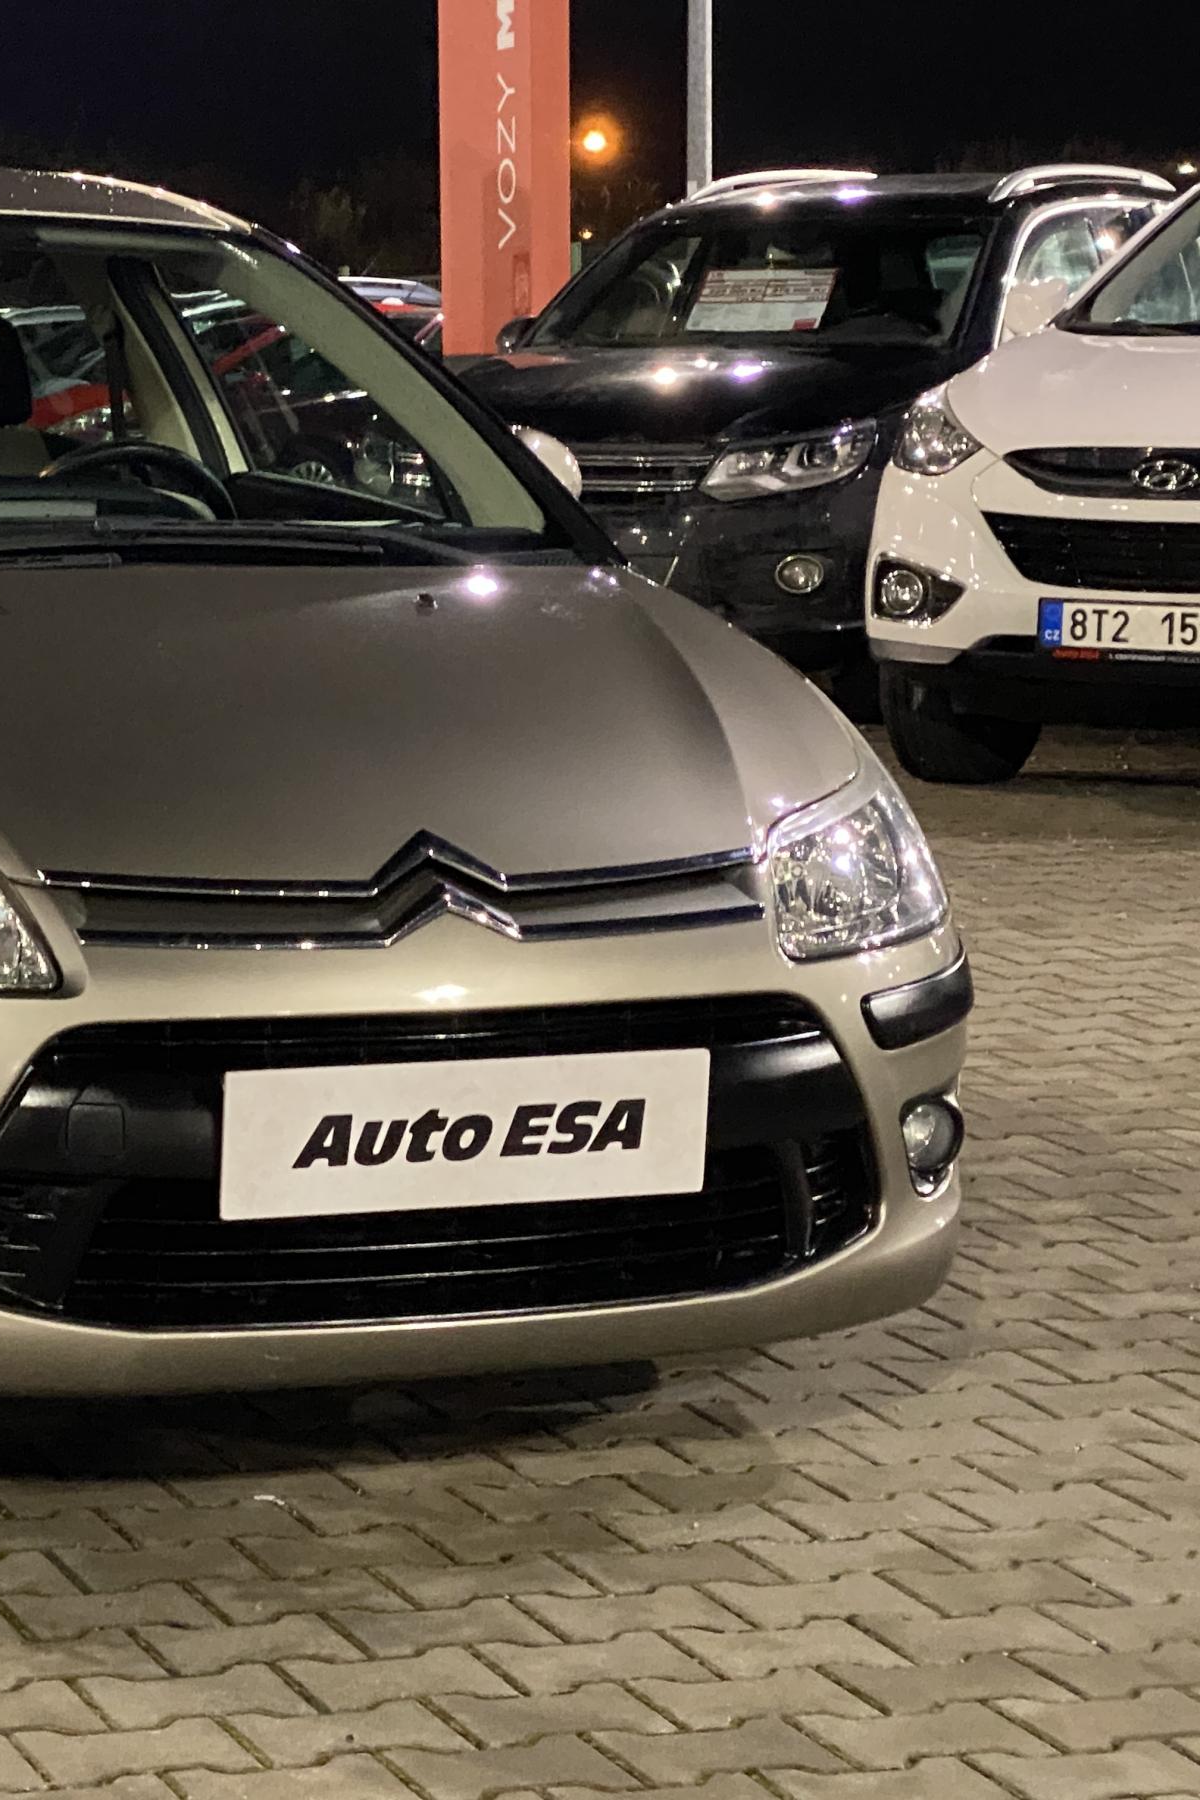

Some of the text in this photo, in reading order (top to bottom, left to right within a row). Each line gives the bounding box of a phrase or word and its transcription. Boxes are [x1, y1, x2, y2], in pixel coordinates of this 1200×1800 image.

[497, 72, 516, 249] VOZY
[1044, 630, 1060, 641] CZ
[1070, 608, 1199, 645] 8T2 15
[292, 1099, 646, 1169] Auto ESA
